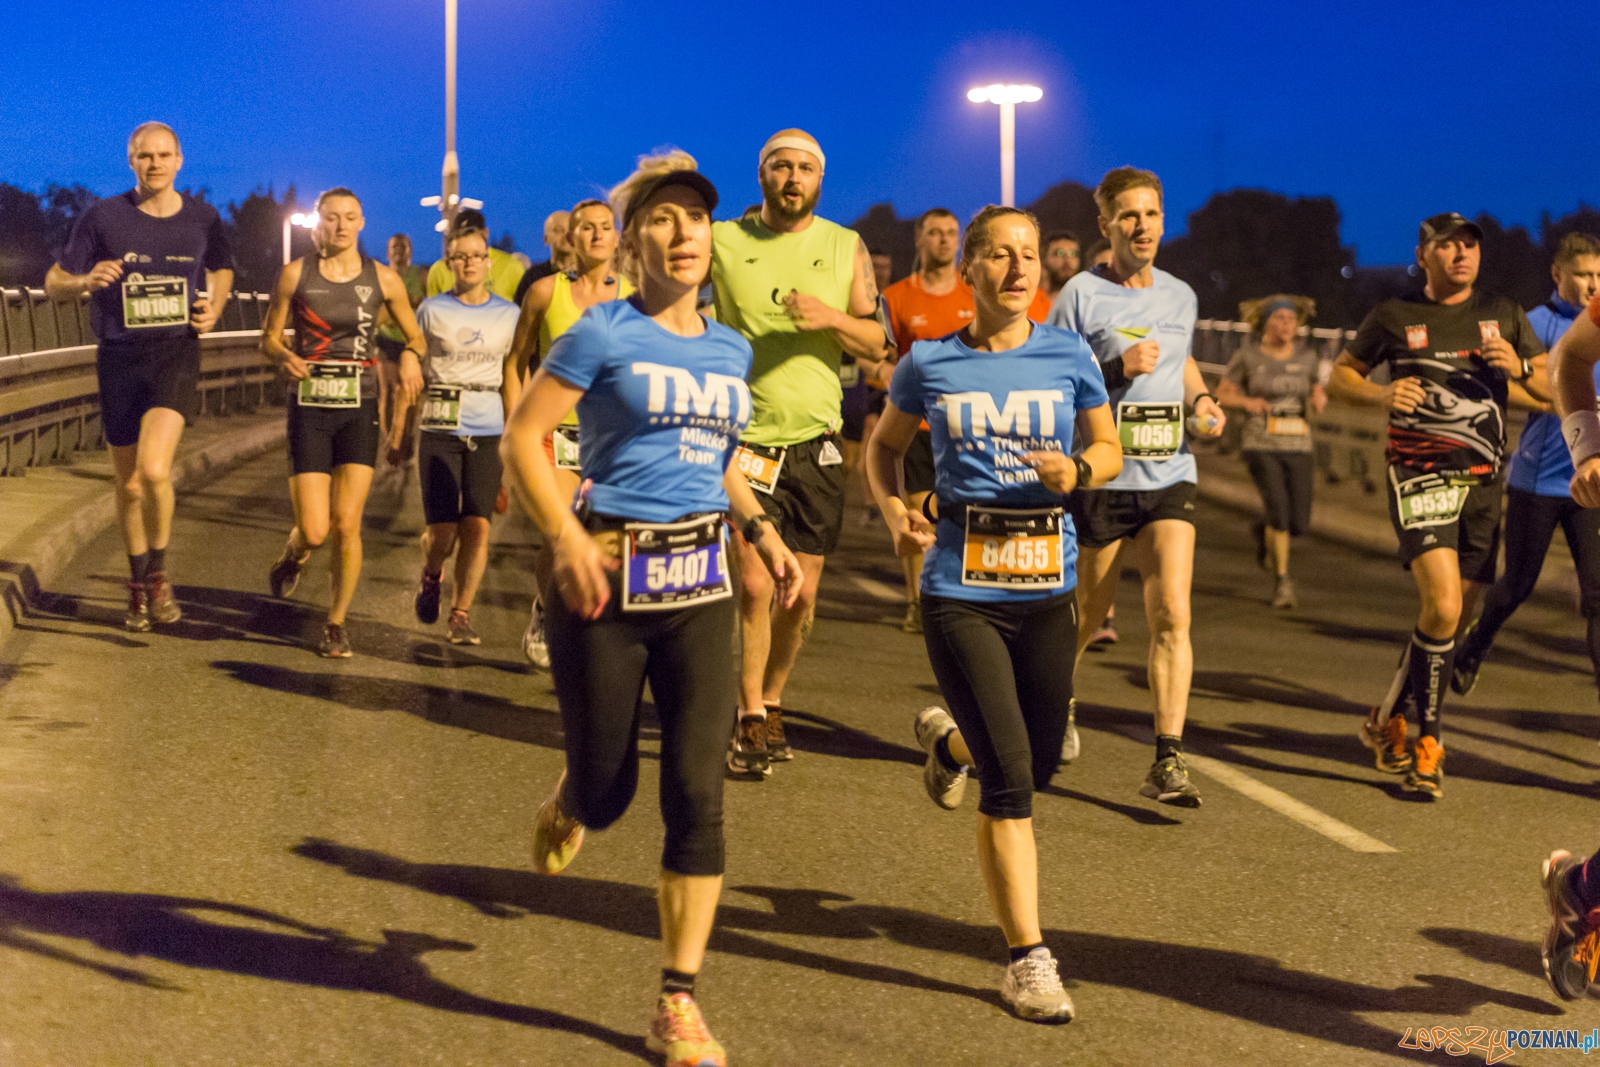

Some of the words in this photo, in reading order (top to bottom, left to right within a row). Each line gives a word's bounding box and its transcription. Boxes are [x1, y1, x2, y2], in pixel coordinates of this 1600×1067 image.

[131, 297, 179, 317] 10106
[310, 379, 348, 397] 7902
[632, 362, 752, 424] TMT
[936, 389, 1064, 440] TMT
[1131, 424, 1174, 447] 1056
[678, 445, 716, 465] Team
[994, 468, 1041, 485] Team
[1409, 489, 1459, 516] 9533
[981, 537, 1049, 571] 8455
[646, 549, 709, 591] 5407
[1425, 654, 1445, 721] Kalenji
